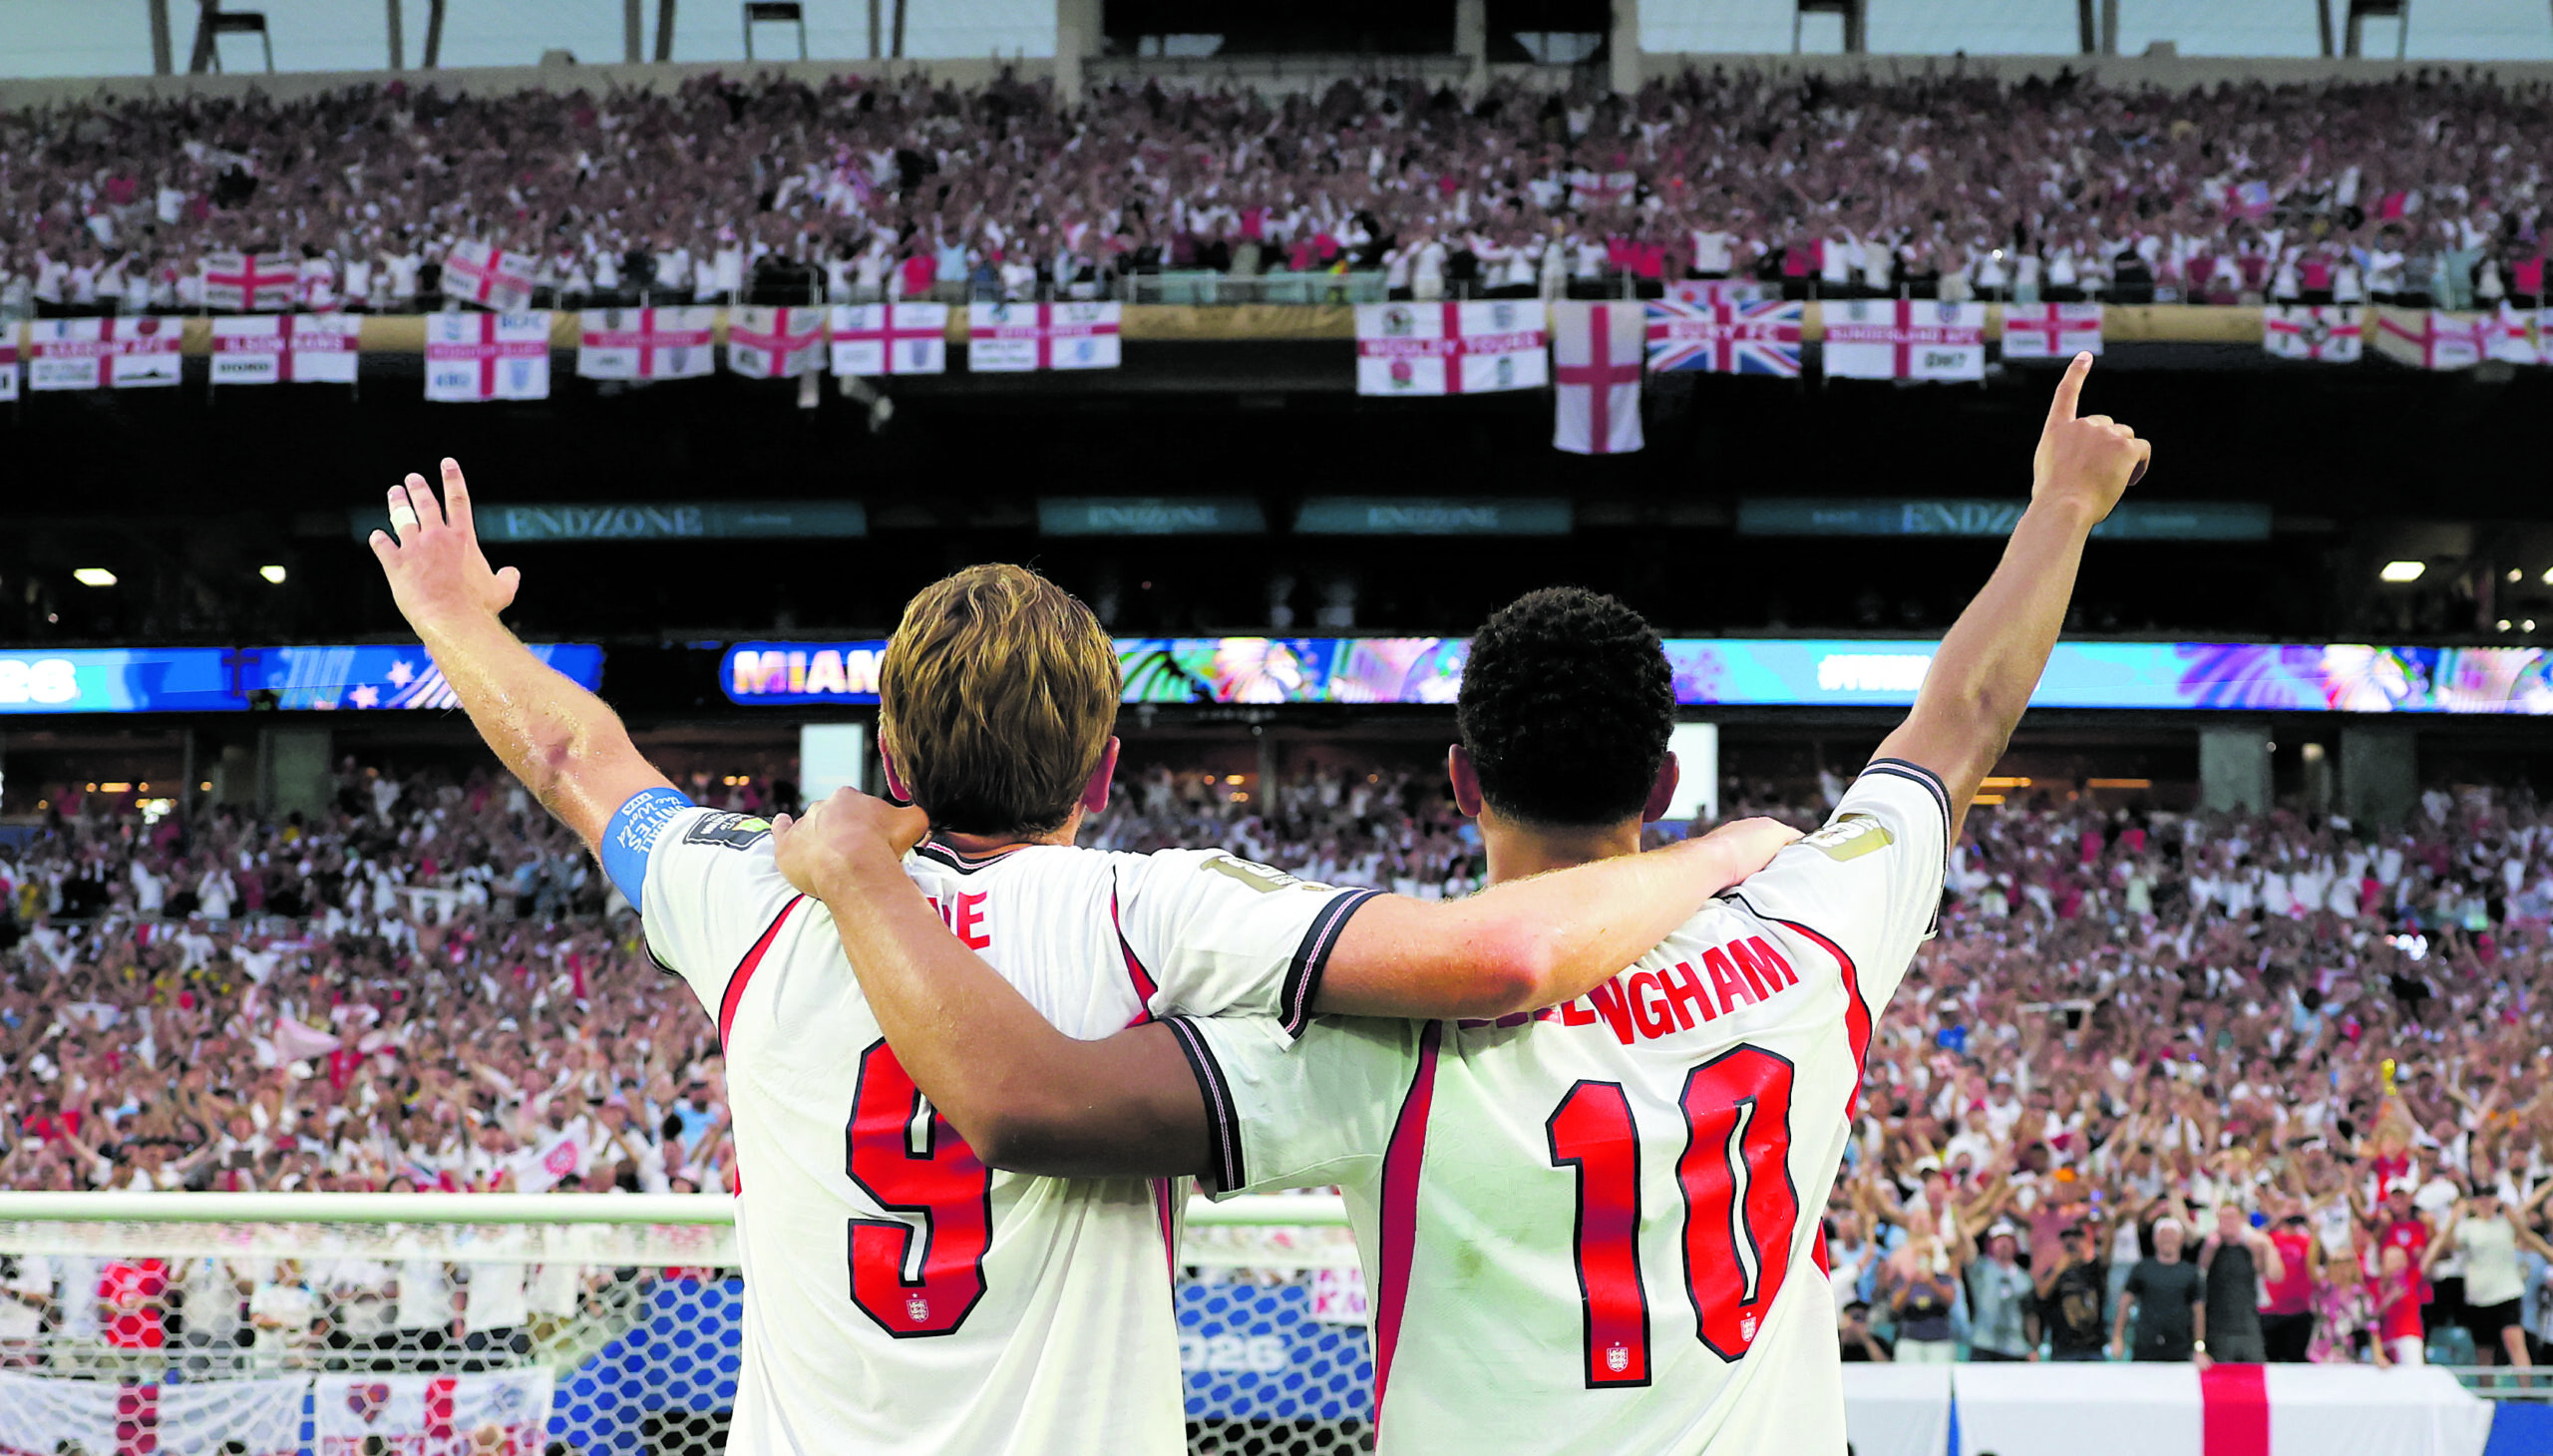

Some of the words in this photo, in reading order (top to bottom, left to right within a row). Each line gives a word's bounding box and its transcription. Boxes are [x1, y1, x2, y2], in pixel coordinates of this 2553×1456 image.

[1669, 321, 1736, 340] BURY
[506, 505, 701, 539] ENDZONE
[616, 801, 659, 850] World
[623, 794, 650, 813] FIFA
[927, 891, 990, 950] E
[846, 1035, 994, 1339] 9
[1546, 1042, 1799, 1389] 10
